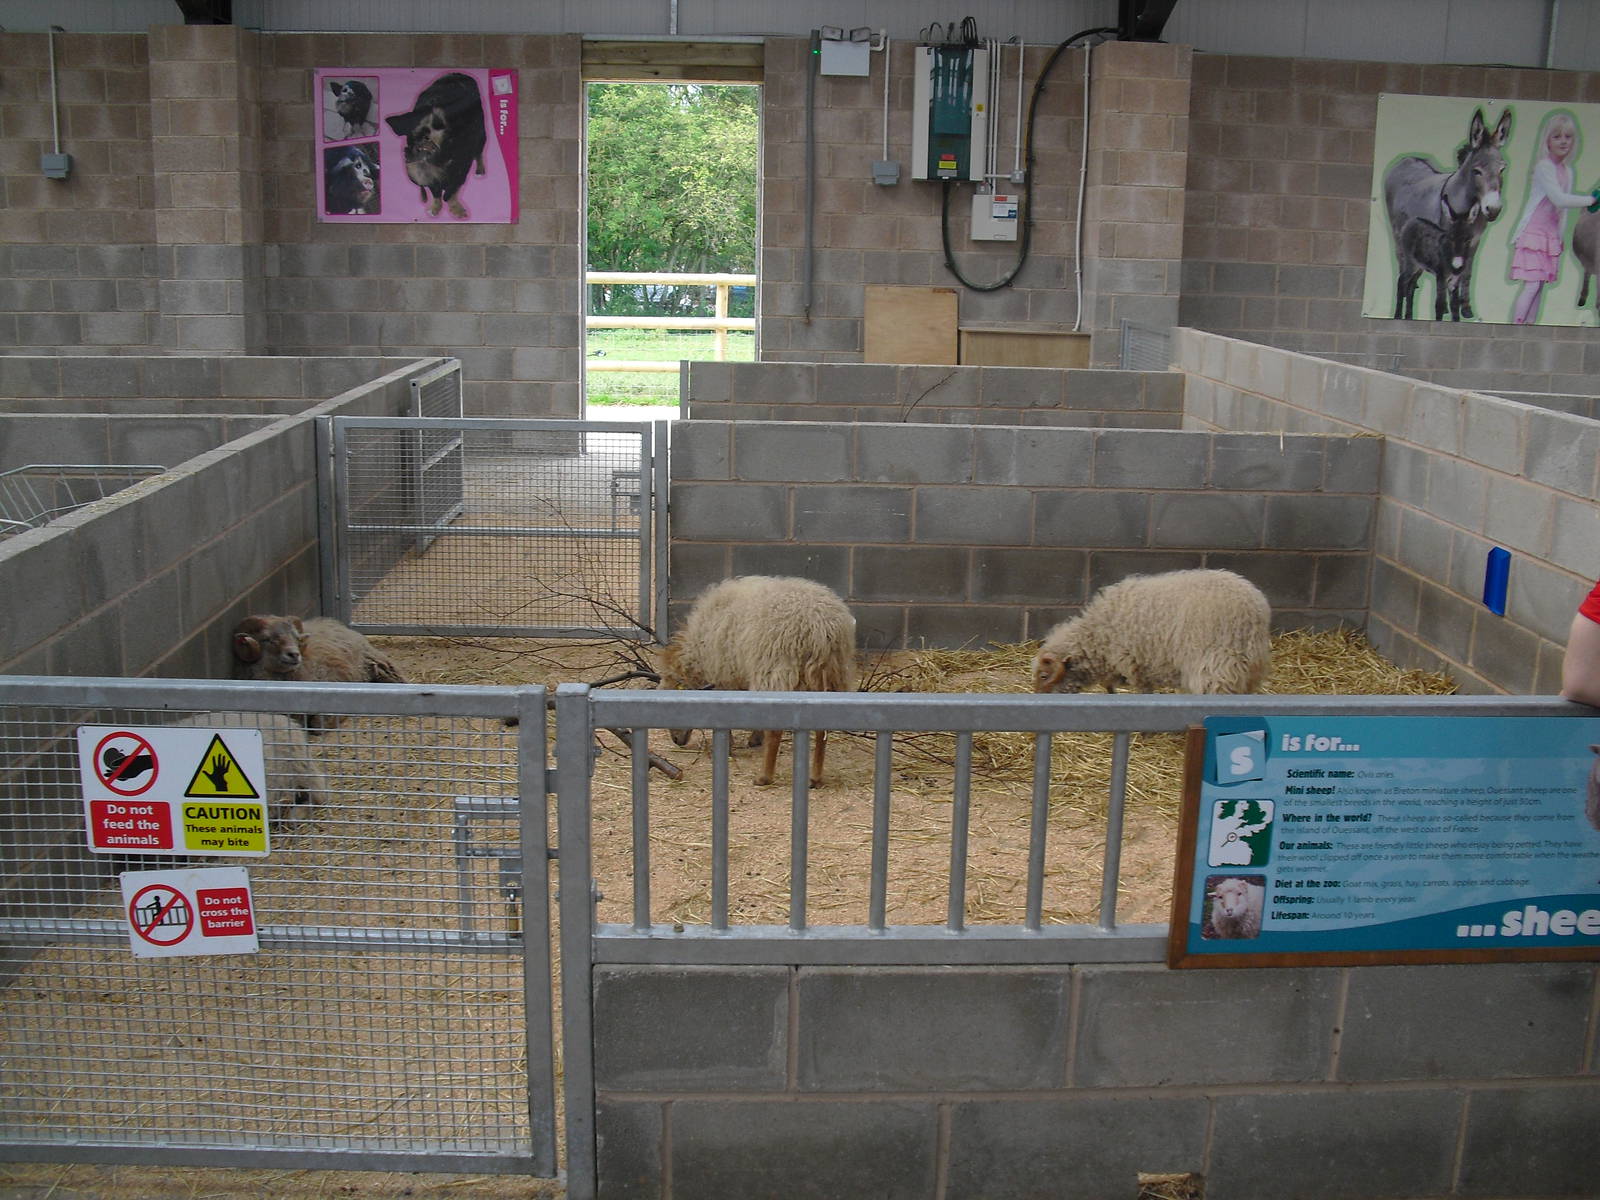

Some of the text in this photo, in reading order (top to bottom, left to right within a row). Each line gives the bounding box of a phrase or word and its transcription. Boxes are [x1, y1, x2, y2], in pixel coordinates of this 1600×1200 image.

[500, 109, 510, 135] for...
[1282, 734, 1360, 751] is for...
[1230, 747, 1254, 775] S
[1287, 769, 1325, 778] Scientific
[1328, 770, 1354, 778] name:
[1285, 786, 1304, 794] Mini
[1306, 786, 1336, 795] sheep!
[1355, 787, 1381, 795] known
[1304, 799, 1342, 807] smallest
[1344, 799, 1371, 807] breeds
[1424, 798, 1457, 807] reaching
[1466, 798, 1492, 807] height
[106, 804, 154, 815] Do not
[185, 807, 261, 820] CAUTION
[1282, 814, 1311, 822] Where
[1314, 814, 1323, 822] in
[1326, 813, 1341, 822] the
[1344, 813, 1372, 822] world?
[1377, 814, 1401, 822] These
[1402, 814, 1426, 823] sheep
[1443, 814, 1478, 822] so-called
[1480, 814, 1511, 822] because
[1514, 814, 1531, 823] they
[102, 818, 160, 830] feed the
[185, 824, 263, 834] These animals
[1321, 826, 1331, 834] of
[1372, 826, 1386, 834] off
[106, 834, 160, 846] animals
[200, 837, 249, 848] may bite
[1279, 841, 1294, 850] Our
[1296, 841, 1333, 850] animals:
[1336, 842, 1360, 850] These
[1374, 842, 1404, 851] friendly
[1406, 841, 1424, 849] little
[1425, 841, 1448, 850] sheep
[1492, 841, 1514, 850] being
[1544, 840, 1562, 849] They
[1564, 840, 1582, 848] have
[1319, 855, 1350, 863] clipped
[1275, 880, 1292, 888] Diet
[1306, 880, 1321, 888] the
[1380, 881, 1402, 889] grass,
[1452, 880, 1477, 888] apples
[204, 895, 242, 905] Do not
[1273, 896, 1315, 905] Offspring:
[1316, 896, 1344, 905] Usually
[1354, 896, 1374, 904] lamb
[1376, 897, 1396, 905] every
[200, 907, 249, 917] cross the
[1271, 911, 1310, 920] Lifespan:
[1311, 911, 1342, 919] Around
[1344, 911, 1353, 919] 10
[207, 919, 246, 929] barrier
